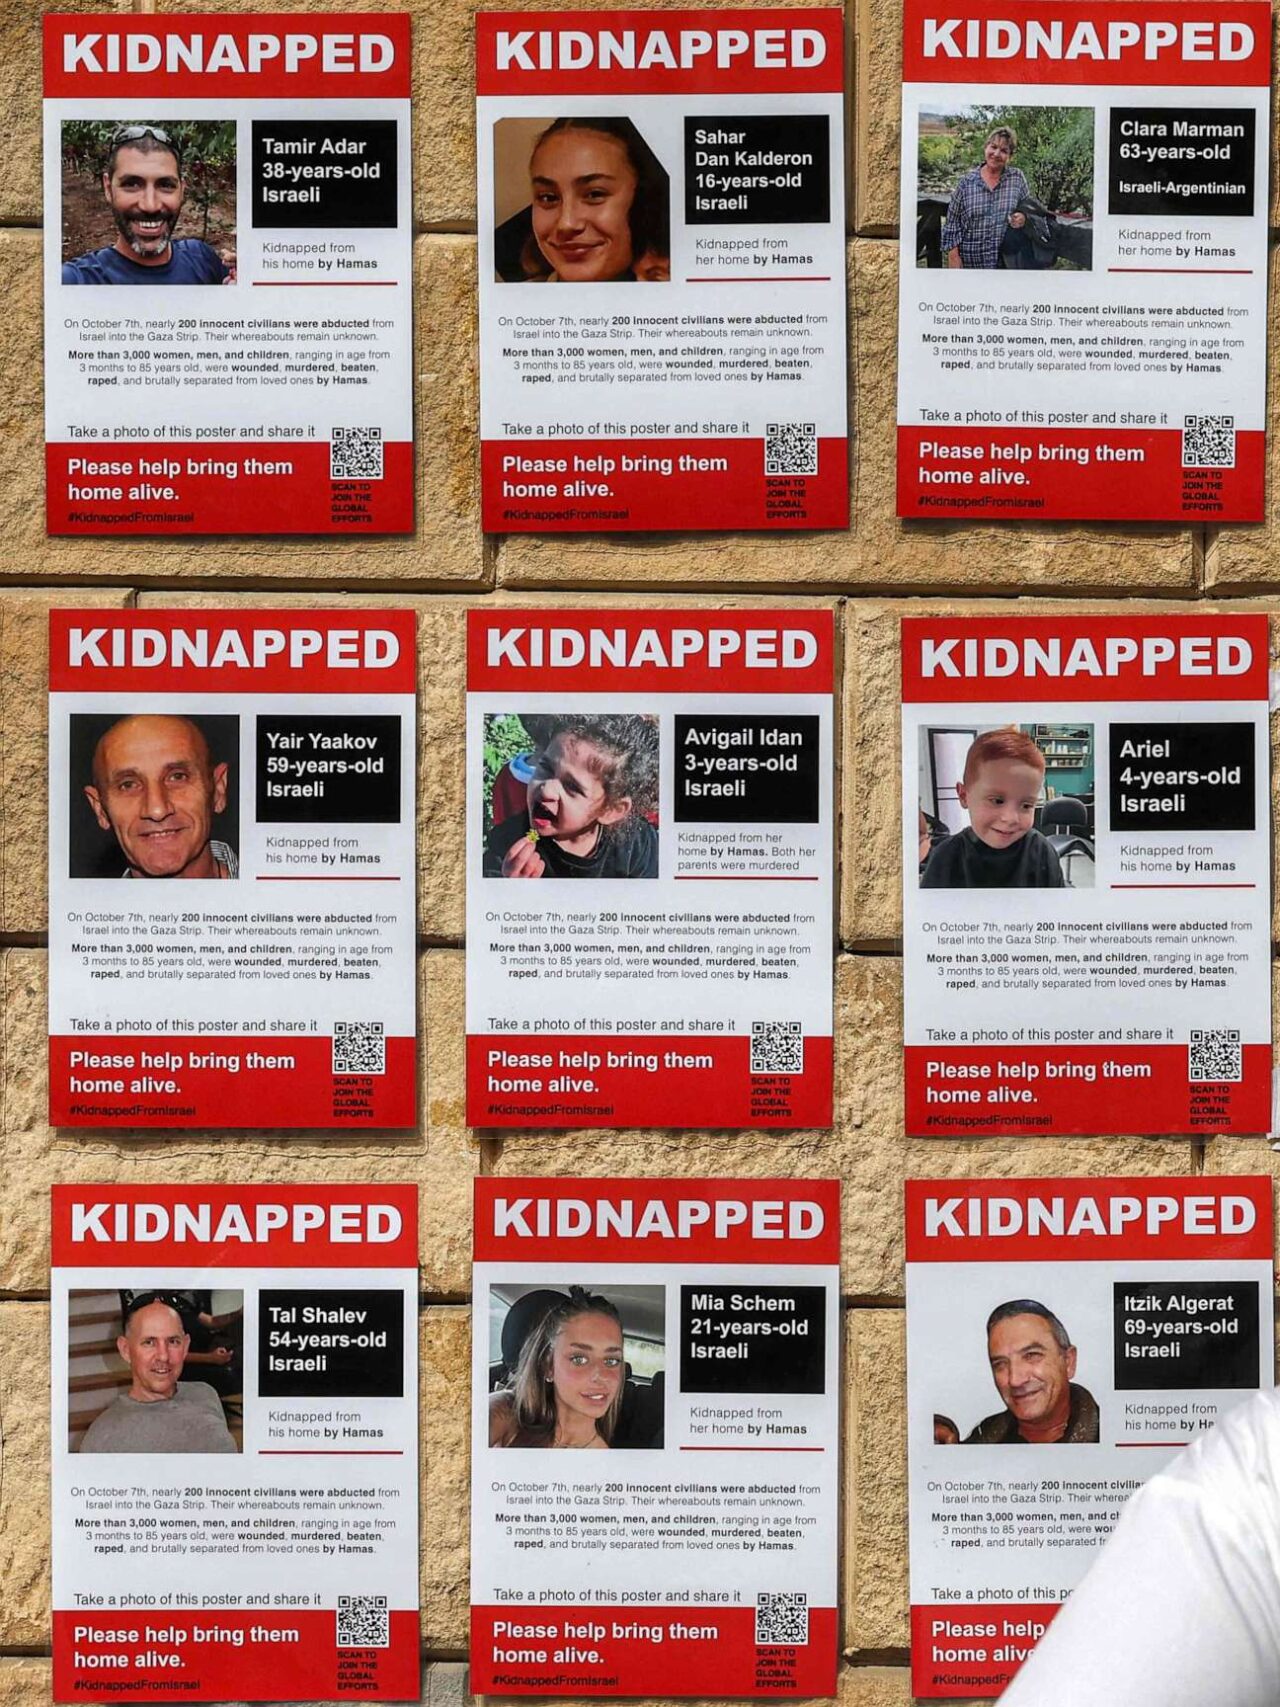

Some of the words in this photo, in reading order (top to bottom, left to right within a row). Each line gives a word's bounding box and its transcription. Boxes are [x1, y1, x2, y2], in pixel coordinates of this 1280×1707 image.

[924, 19, 1254, 60] KIDNAPPED
[64, 35, 394, 72] KIDNAPPED
[497, 30, 826, 69] KIDNAPPED
[696, 130, 745, 144] Sahar
[1121, 121, 1166, 136] Clara
[1174, 122, 1243, 136] Marman
[263, 138, 316, 154] Tamir
[320, 139, 366, 154] Adar
[1120, 144, 1230, 162] 63-years-old
[696, 152, 728, 166] Dan
[736, 152, 812, 165] Kalderon
[263, 163, 379, 182] 38-years-old
[696, 173, 801, 191] 16-years-old
[1120, 181, 1245, 196] Israeli-Argentinian
[264, 187, 319, 202] Israeli
[696, 195, 747, 209] Israeli
[262, 242, 326, 256] Kidnapped
[329, 242, 356, 253] from
[262, 259, 279, 269] his
[282, 259, 315, 269] home
[317, 258, 333, 272] by
[336, 258, 378, 269] Hamas
[919, 408, 950, 421] Take
[953, 411, 962, 422] a
[965, 409, 1002, 425] photo
[1005, 410, 1018, 423] of
[1021, 410, 1045, 423] this
[1047, 411, 1089, 426] poster
[1092, 411, 1117, 424] and
[1120, 411, 1157, 425] share
[1160, 412, 1168, 425] it
[70, 629, 399, 668] KIDNAPPED
[488, 629, 817, 667] KIDNAPPED
[922, 638, 1252, 677] KIDNAPPED
[267, 733, 304, 748] Yair
[309, 733, 377, 749] Yaakov
[685, 729, 752, 749] Avigail
[761, 729, 802, 745] Idan
[1120, 740, 1169, 757] Ariel
[268, 757, 383, 776] 59-years-old
[686, 754, 797, 774] 3-years-old
[1120, 767, 1240, 789] 4-years-old
[268, 781, 323, 796] Israeli
[686, 780, 745, 796] Israeli
[1122, 794, 1184, 812] Israeli
[678, 832, 736, 845] Kidnapped
[739, 832, 763, 843] from
[765, 833, 783, 844] her
[677, 847, 707, 856] home
[710, 846, 724, 859] by
[727, 846, 769, 857] Hamas.
[771, 846, 796, 857] Both
[798, 847, 816, 857] her
[677, 860, 718, 872] parents
[720, 861, 746, 871] were
[748, 860, 800, 871] murdered
[927, 1062, 991, 1077] Please
[998, 1062, 1039, 1081] help
[1046, 1062, 1095, 1081] bring
[1103, 1061, 1150, 1077] them
[927, 1087, 980, 1102] home
[988, 1087, 1037, 1102] alive.
[72, 1204, 401, 1242] KIDNAPPED
[495, 1199, 823, 1239] KIDNAPPED
[926, 1197, 1255, 1236] KIDNAPPED
[692, 1295, 724, 1310] Mia
[731, 1295, 795, 1310] Schem
[1125, 1296, 1161, 1311] Itzik
[1167, 1296, 1233, 1314] Algerat
[269, 1308, 295, 1323] Tal
[303, 1307, 366, 1323] Shalev
[692, 1319, 808, 1338] 21-years-old
[1125, 1319, 1237, 1337] 69-years-old
[270, 1332, 386, 1350] 54-years-old
[1126, 1342, 1179, 1357] Israeli
[692, 1343, 747, 1358] Israeli
[270, 1355, 326, 1371] Israeli
[74, 1518, 101, 1528] More
[103, 1518, 127, 1528] than
[129, 1518, 157, 1529] 3,000
[230, 1518, 251, 1528] and
[301, 1519, 339, 1530] ranging
[341, 1520, 350, 1528] in
[352, 1520, 372, 1530] age
[374, 1519, 396, 1528] from
